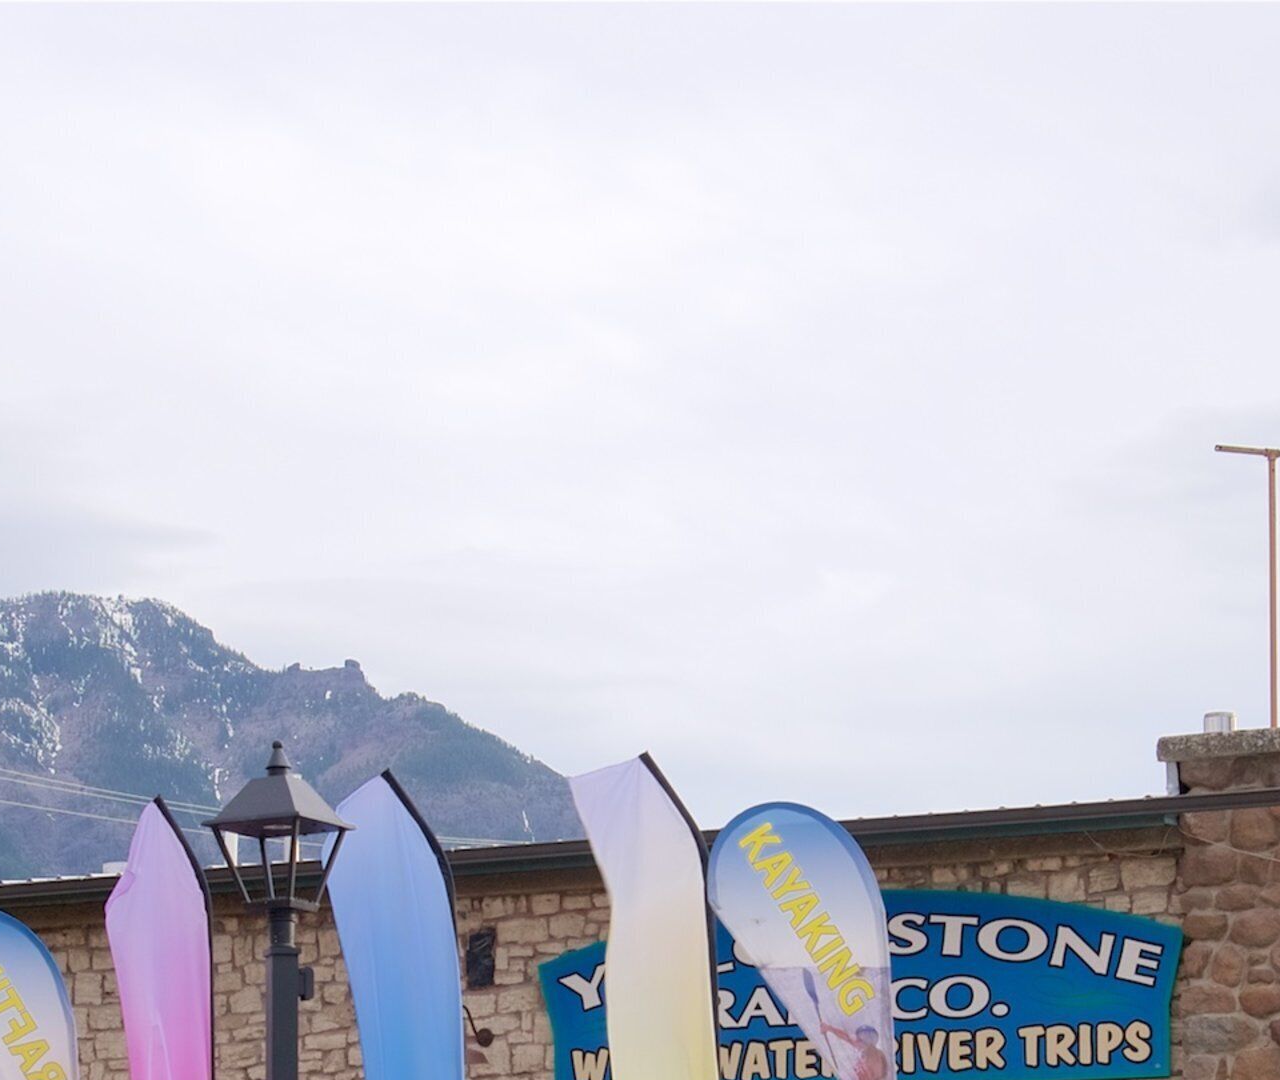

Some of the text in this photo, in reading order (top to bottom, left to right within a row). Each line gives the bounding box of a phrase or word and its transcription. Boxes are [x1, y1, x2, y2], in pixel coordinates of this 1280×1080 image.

[738, 821, 876, 1016] KAYAKING
[890, 974, 1010, 1020] CO.
[895, 1027, 1006, 1074] IVER
[1018, 1019, 1152, 1068] TRIPS
